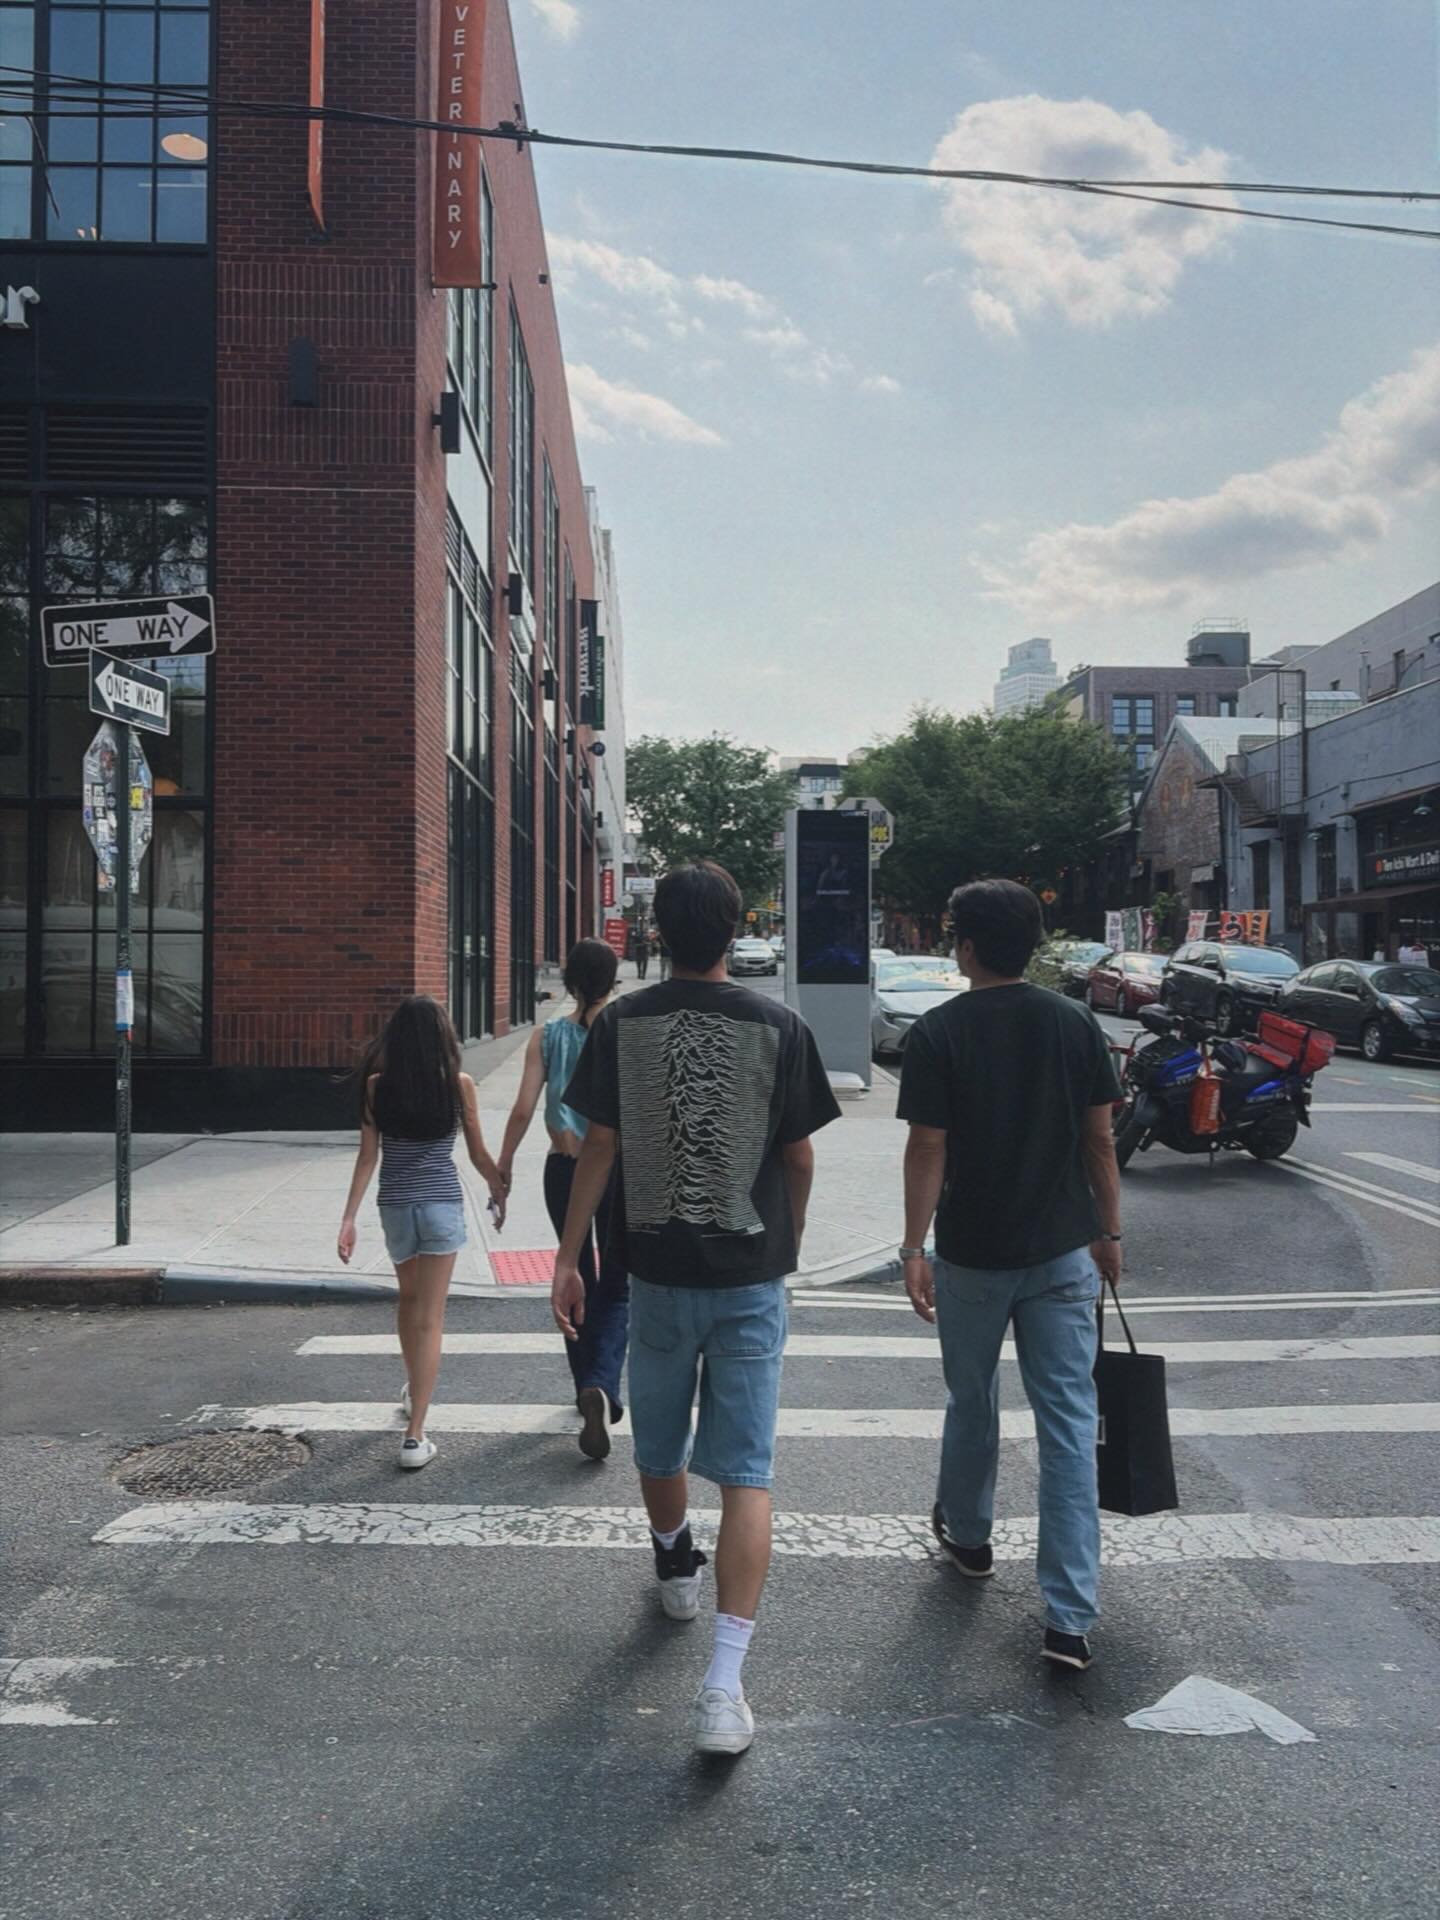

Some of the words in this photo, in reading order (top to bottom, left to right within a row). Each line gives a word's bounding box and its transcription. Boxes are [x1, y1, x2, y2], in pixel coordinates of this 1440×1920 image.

[447, 5, 469, 249] VETERINARY
[59, 622, 109, 647] ONE
[136, 615, 190, 641] WAY
[105, 674, 130, 703] ONE
[135, 686, 160, 713] WAY
